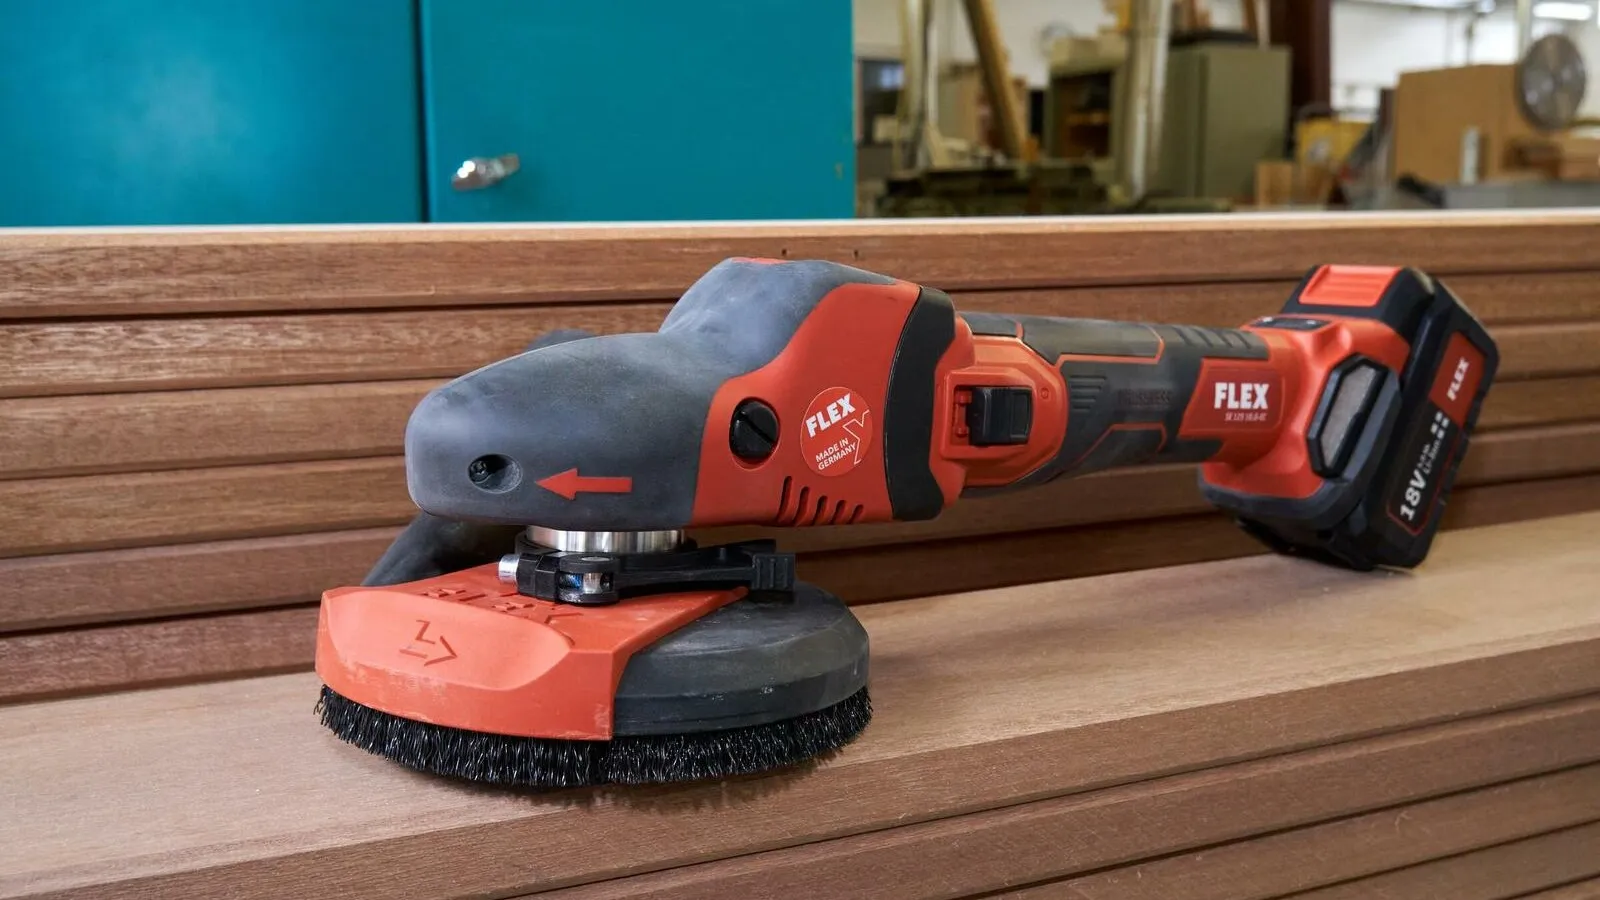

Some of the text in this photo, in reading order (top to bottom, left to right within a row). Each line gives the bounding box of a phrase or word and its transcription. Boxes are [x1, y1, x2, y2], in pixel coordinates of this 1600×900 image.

[1214, 382, 1270, 409] FLEX
[1446, 356, 1469, 401] FLEX
[805, 393, 856, 438] FLEX
[815, 437, 850, 463] MADE IN
[818, 442, 856, 470] GERMANY
[1400, 469, 1426, 521] 18V
